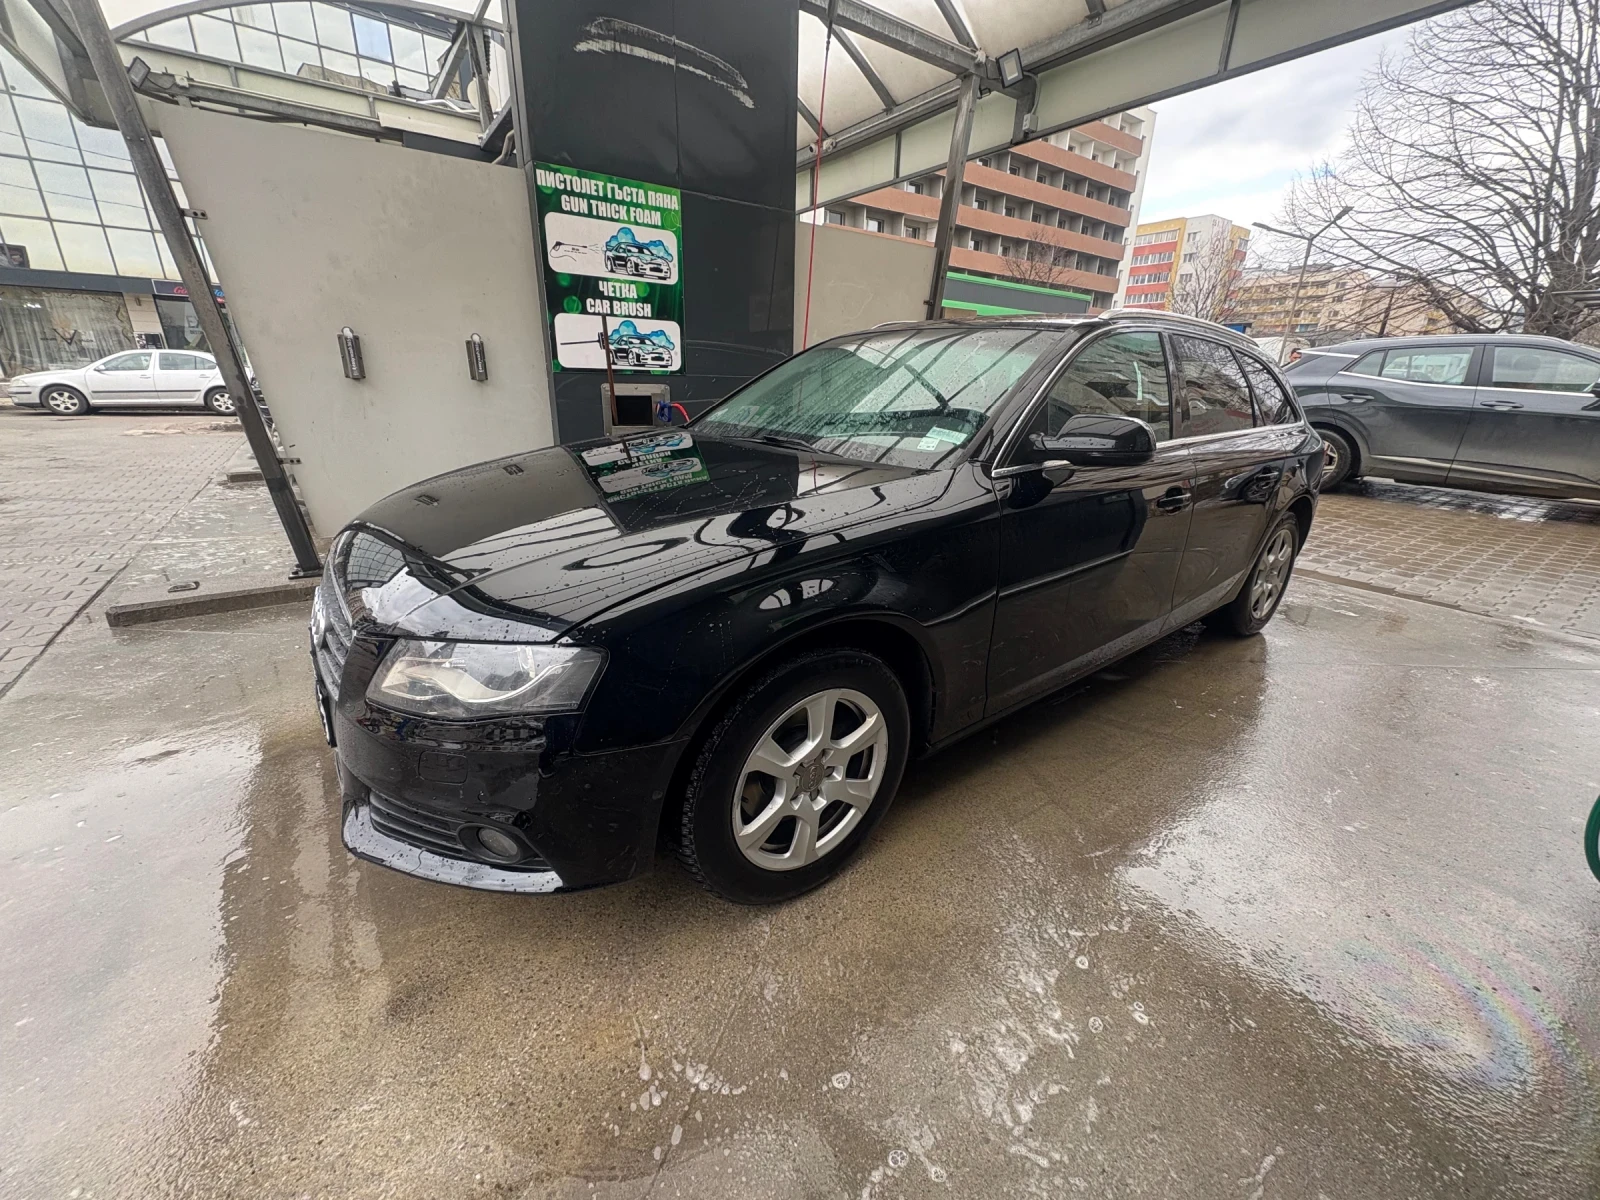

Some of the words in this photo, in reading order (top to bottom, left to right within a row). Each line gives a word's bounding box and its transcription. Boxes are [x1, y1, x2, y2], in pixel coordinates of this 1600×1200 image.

[536, 168, 604, 197] ПИСТОЛЕТ
[606, 183, 646, 205] ГЪСТА
[647, 190, 679, 210] ПЯНА
[561, 194, 588, 214] GUN
[590, 199, 628, 221] THICK
[629, 206, 661, 226] FOAM
[598, 280, 638, 299] ЧЕТКА
[586, 297, 611, 314] CAR
[612, 300, 652, 317] BRUSH
